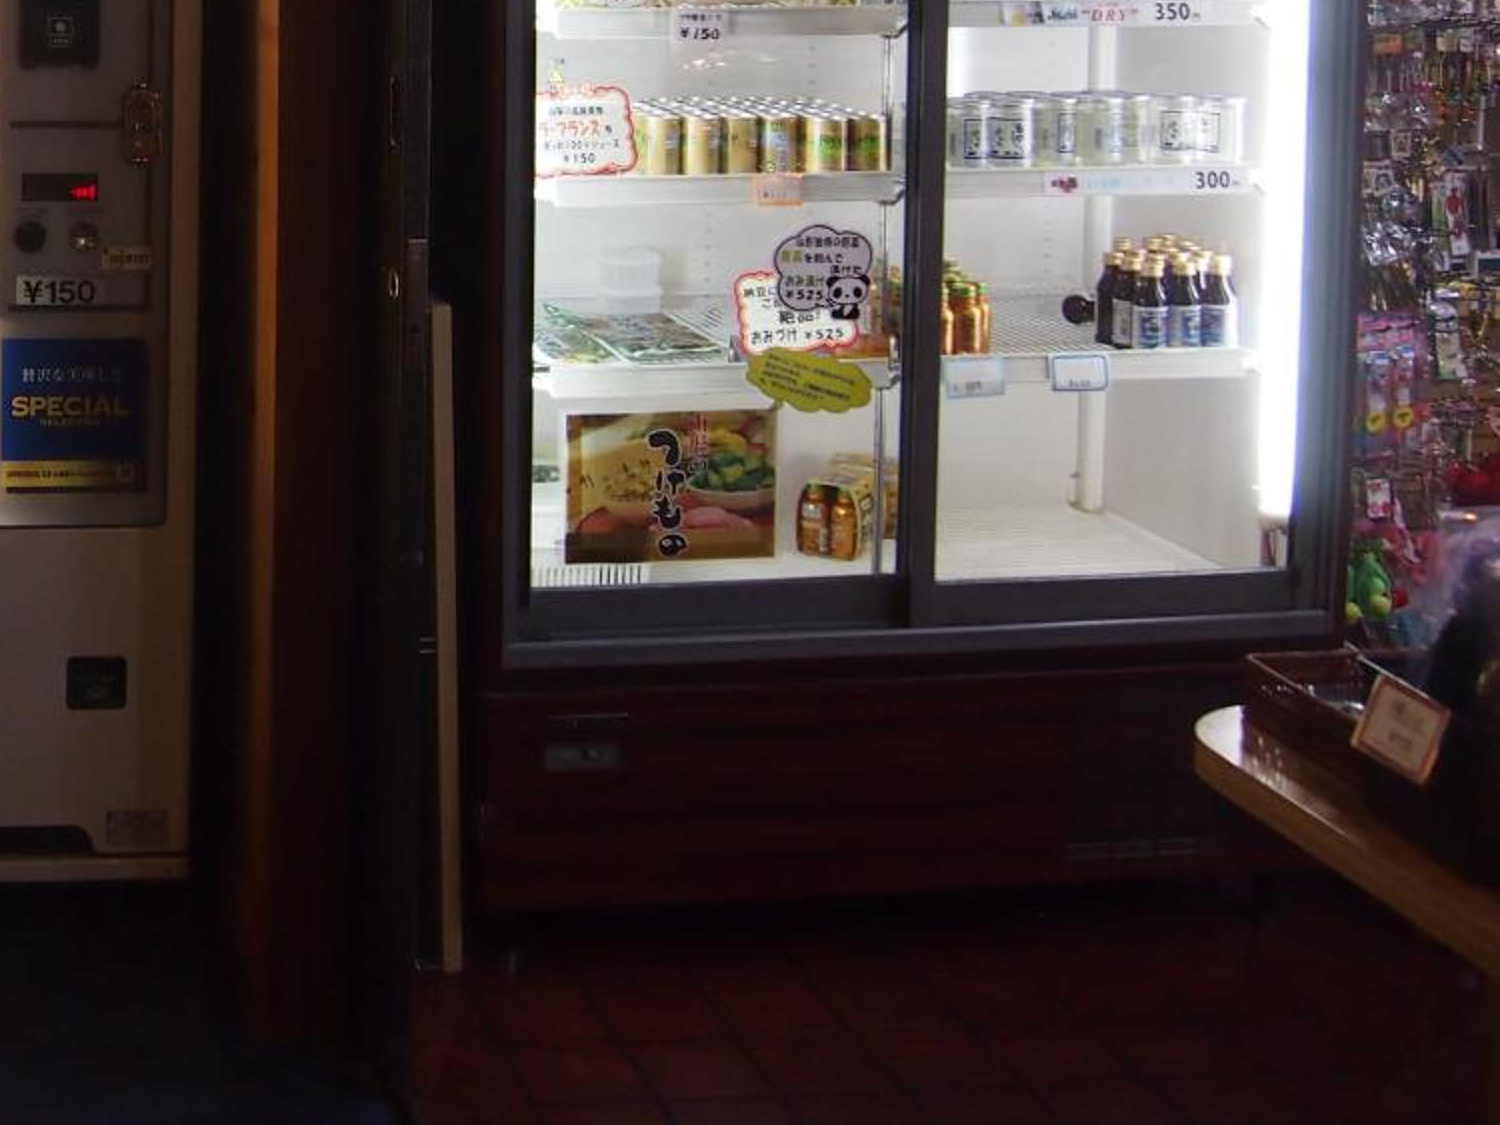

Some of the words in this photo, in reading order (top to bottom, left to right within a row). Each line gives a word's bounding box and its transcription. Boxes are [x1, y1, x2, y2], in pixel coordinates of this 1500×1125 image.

[680, 26, 721, 40] ¥150
[23, 279, 96, 304] ¥150
[11, 395, 132, 418] SPECIAL
